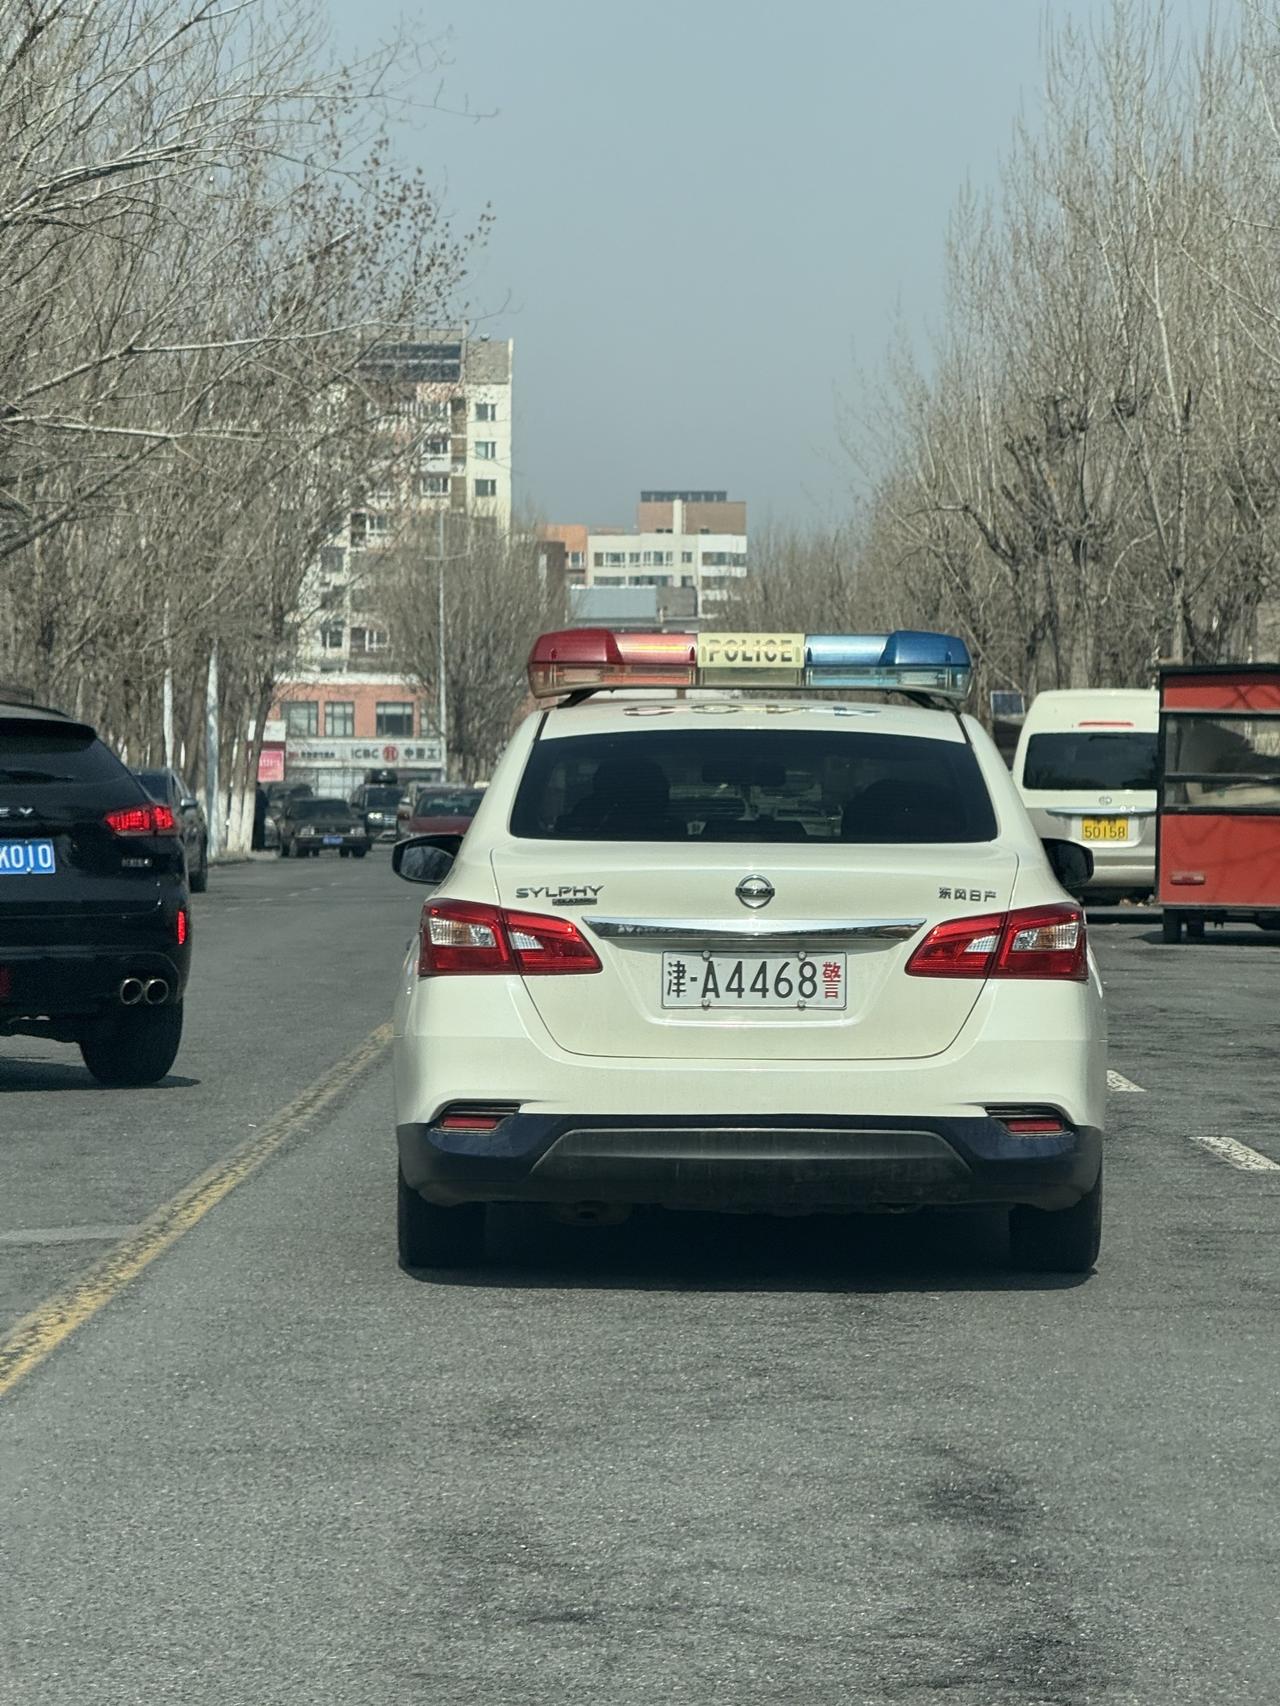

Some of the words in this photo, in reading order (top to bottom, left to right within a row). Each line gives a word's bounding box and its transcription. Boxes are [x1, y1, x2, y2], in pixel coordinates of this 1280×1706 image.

[709, 639, 793, 662] POLICE
[1085, 826, 1126, 839] 50158
[516, 885, 604, 899] SYLPHY
[938, 887, 997, 903] 东风日产
